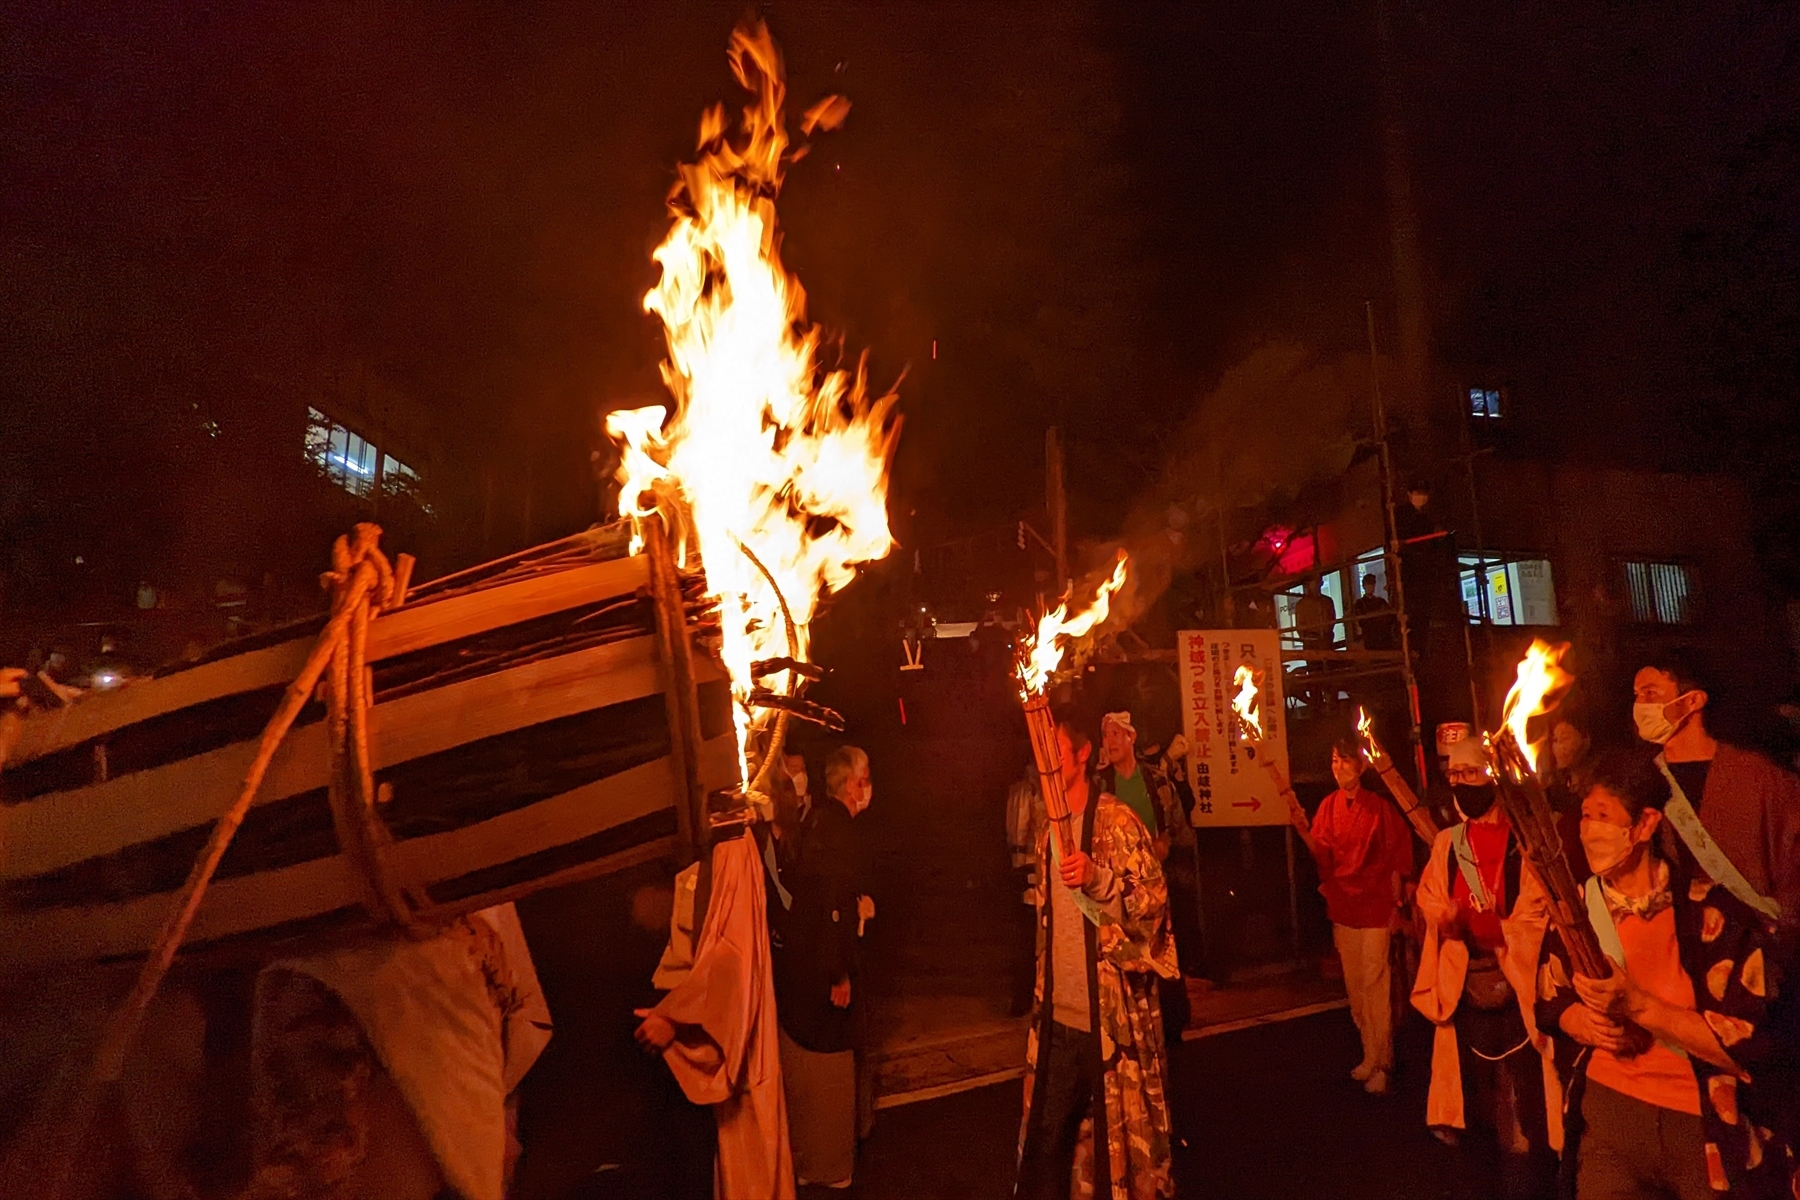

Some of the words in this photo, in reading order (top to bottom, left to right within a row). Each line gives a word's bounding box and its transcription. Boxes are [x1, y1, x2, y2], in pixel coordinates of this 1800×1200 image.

[1189, 635, 1213, 758] 神域つき立入禁止
